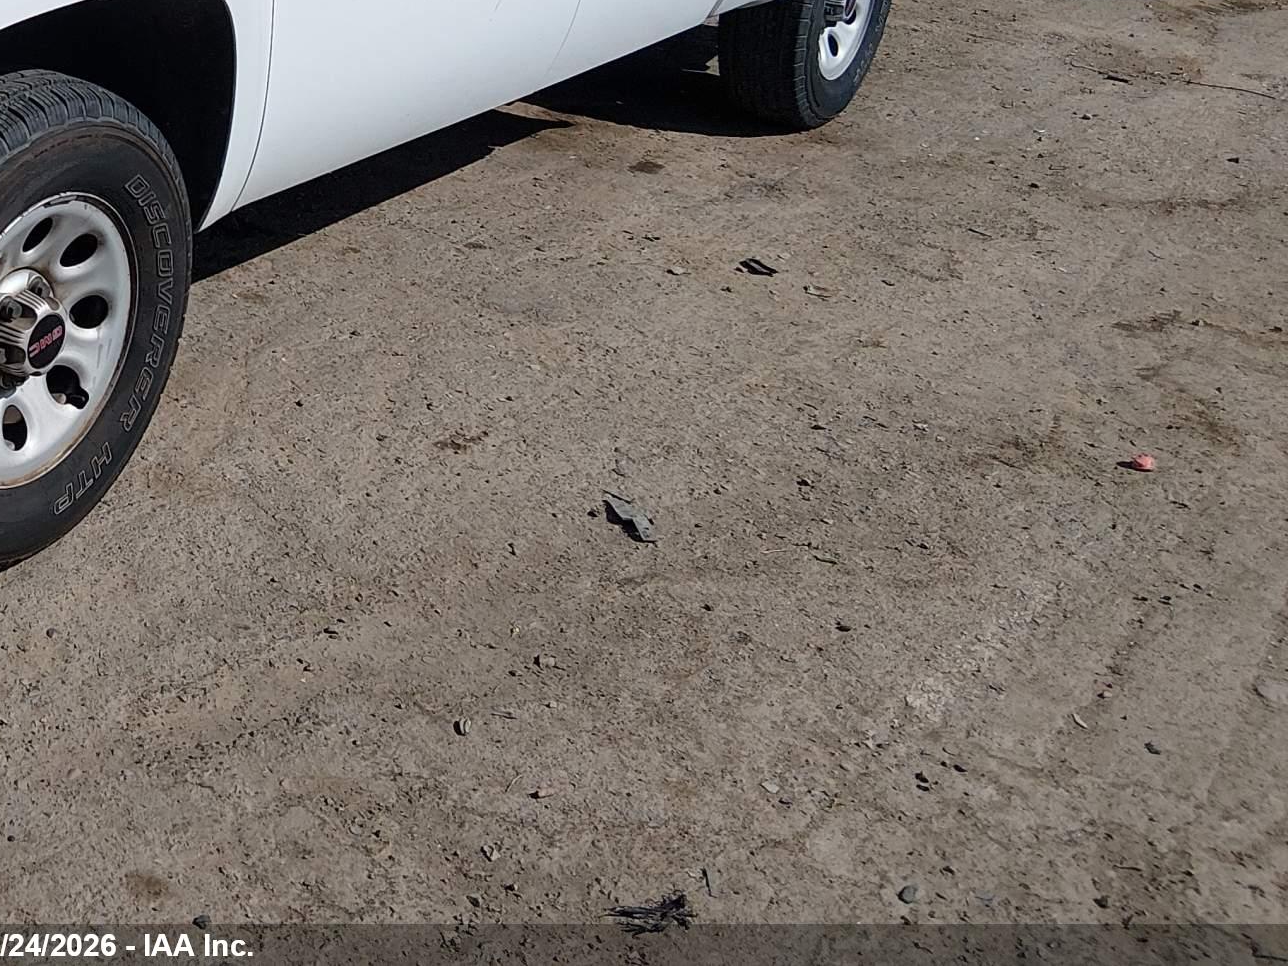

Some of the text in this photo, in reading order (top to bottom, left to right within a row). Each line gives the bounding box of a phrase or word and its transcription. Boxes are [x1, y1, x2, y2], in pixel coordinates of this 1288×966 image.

[28, 324, 63, 358] GMC
[53, 174, 174, 515] DISCOVERER HTP
